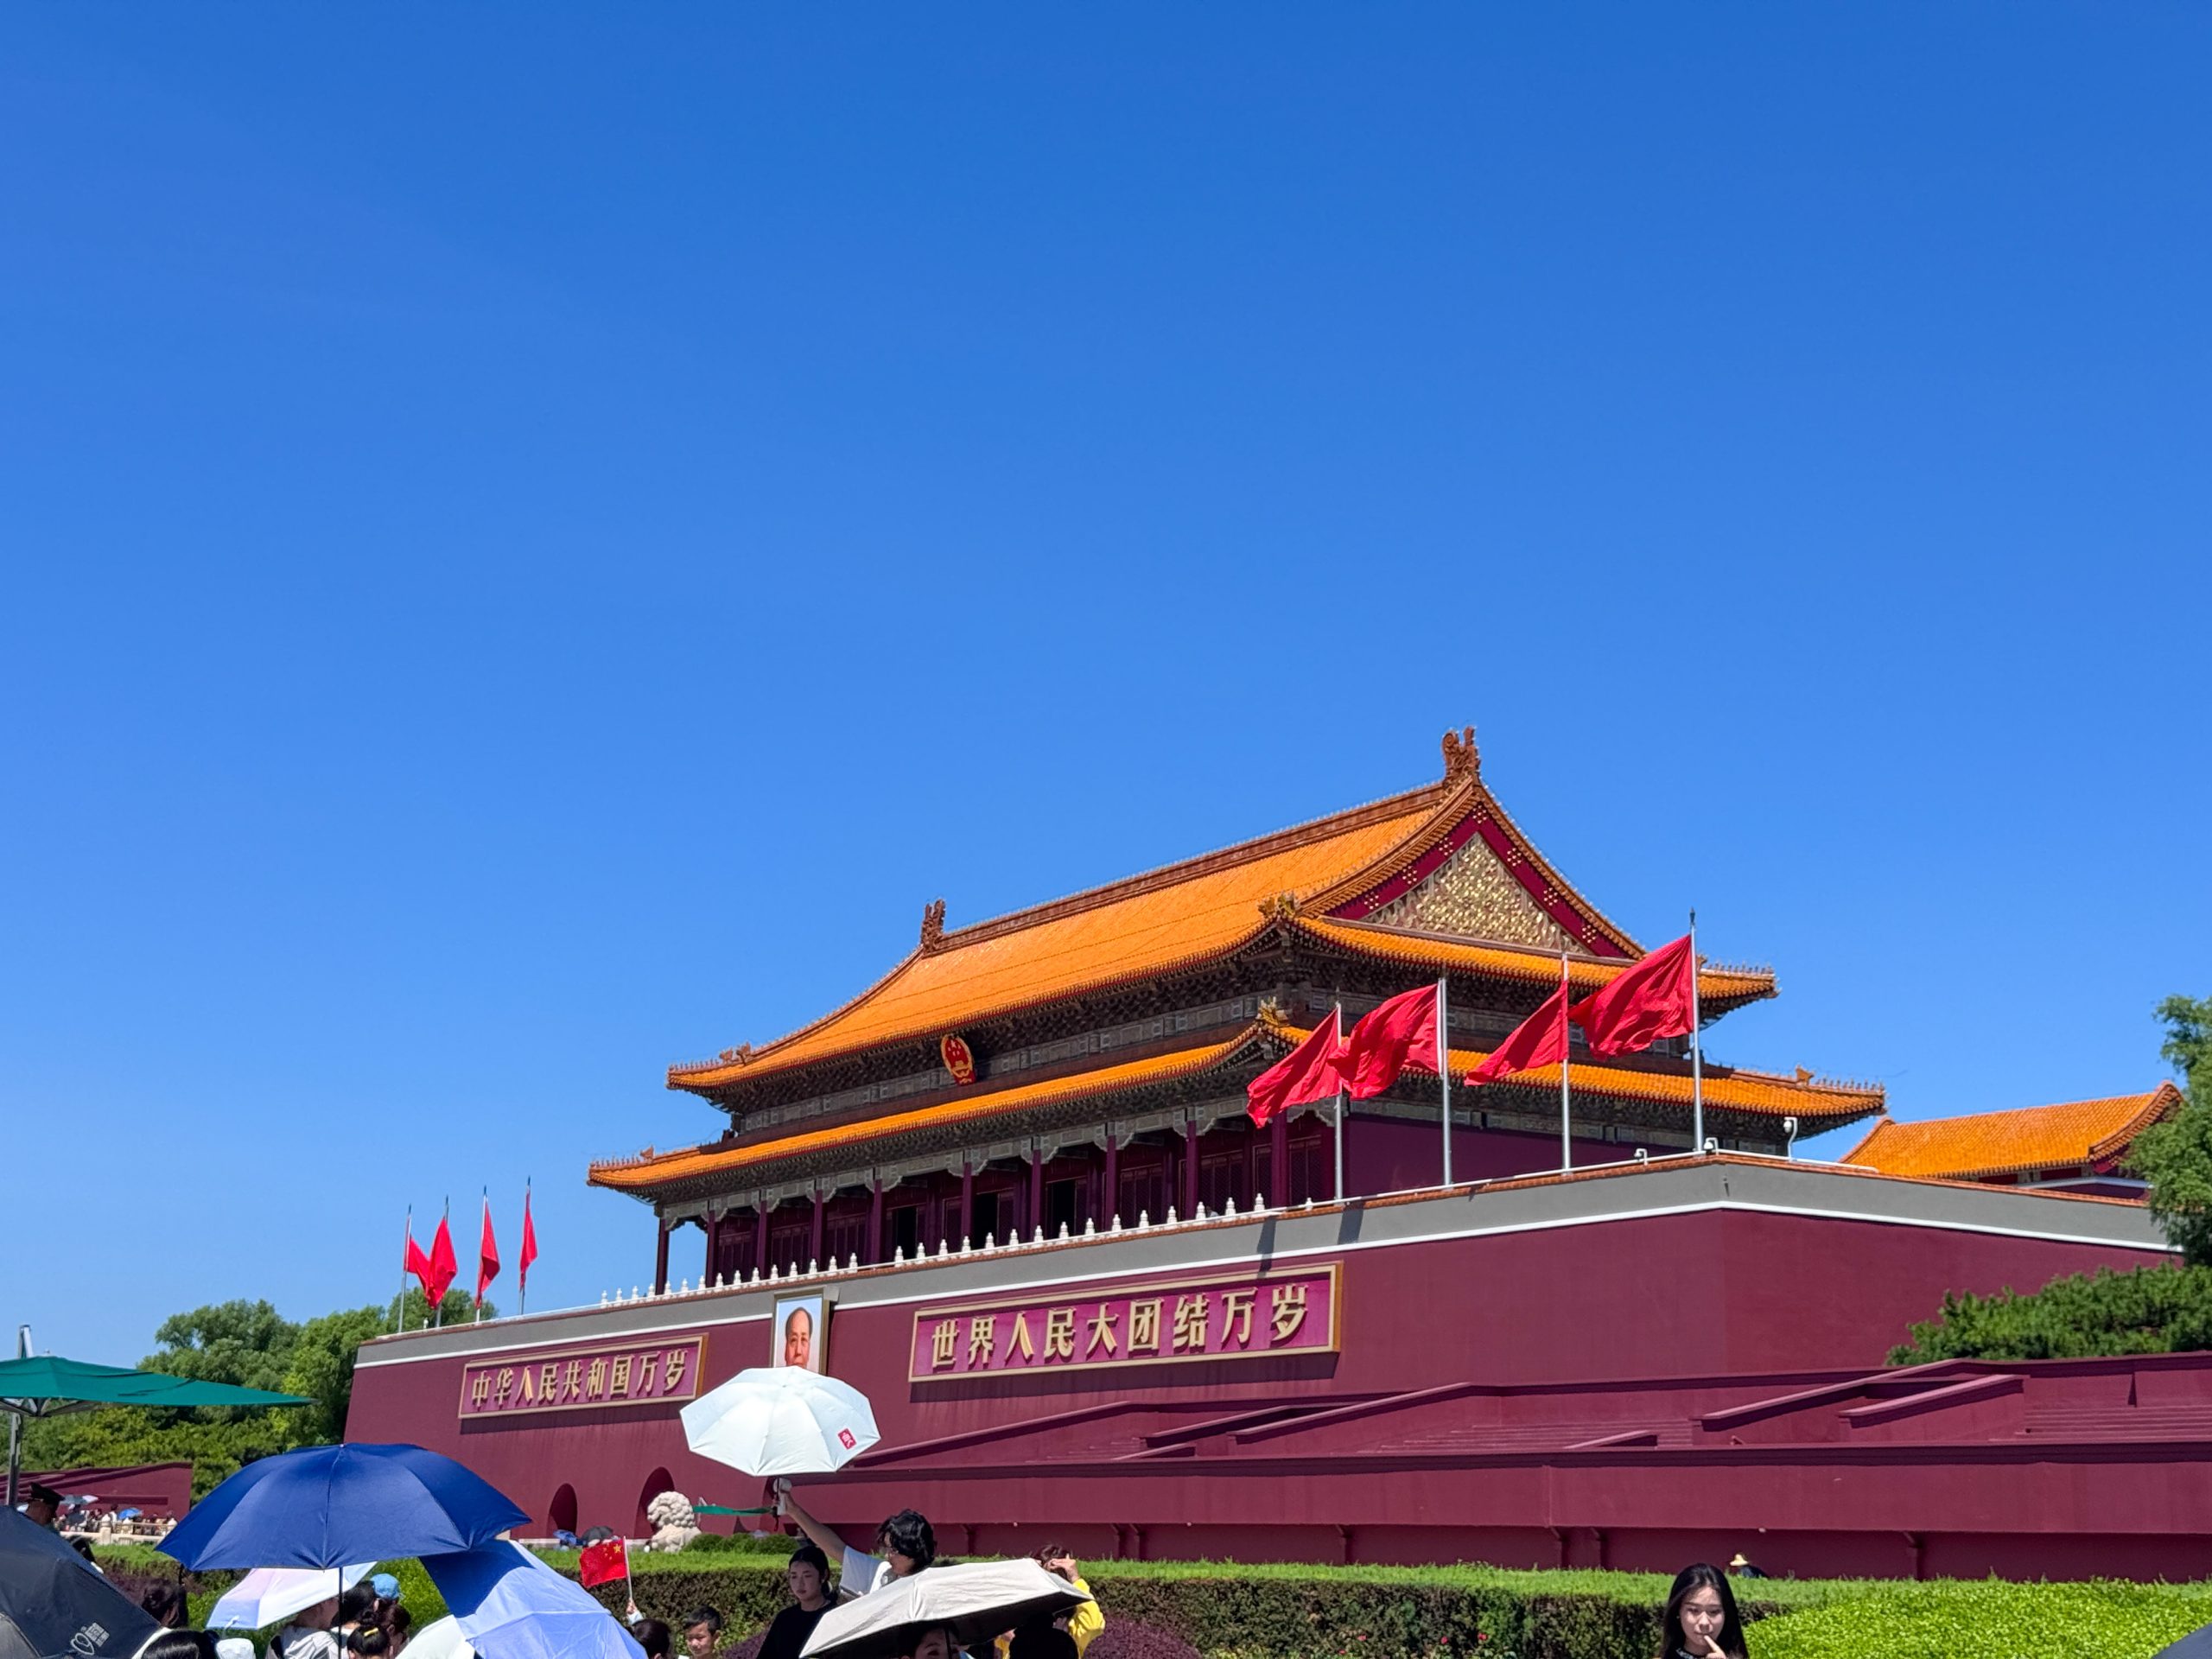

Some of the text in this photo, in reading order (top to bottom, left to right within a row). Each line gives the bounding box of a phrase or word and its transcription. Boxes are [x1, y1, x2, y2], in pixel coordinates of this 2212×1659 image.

[931, 1284, 1308, 1369] 世界人民大团结万岁
[472, 1350, 688, 1408] 中华人民共和国万岁
